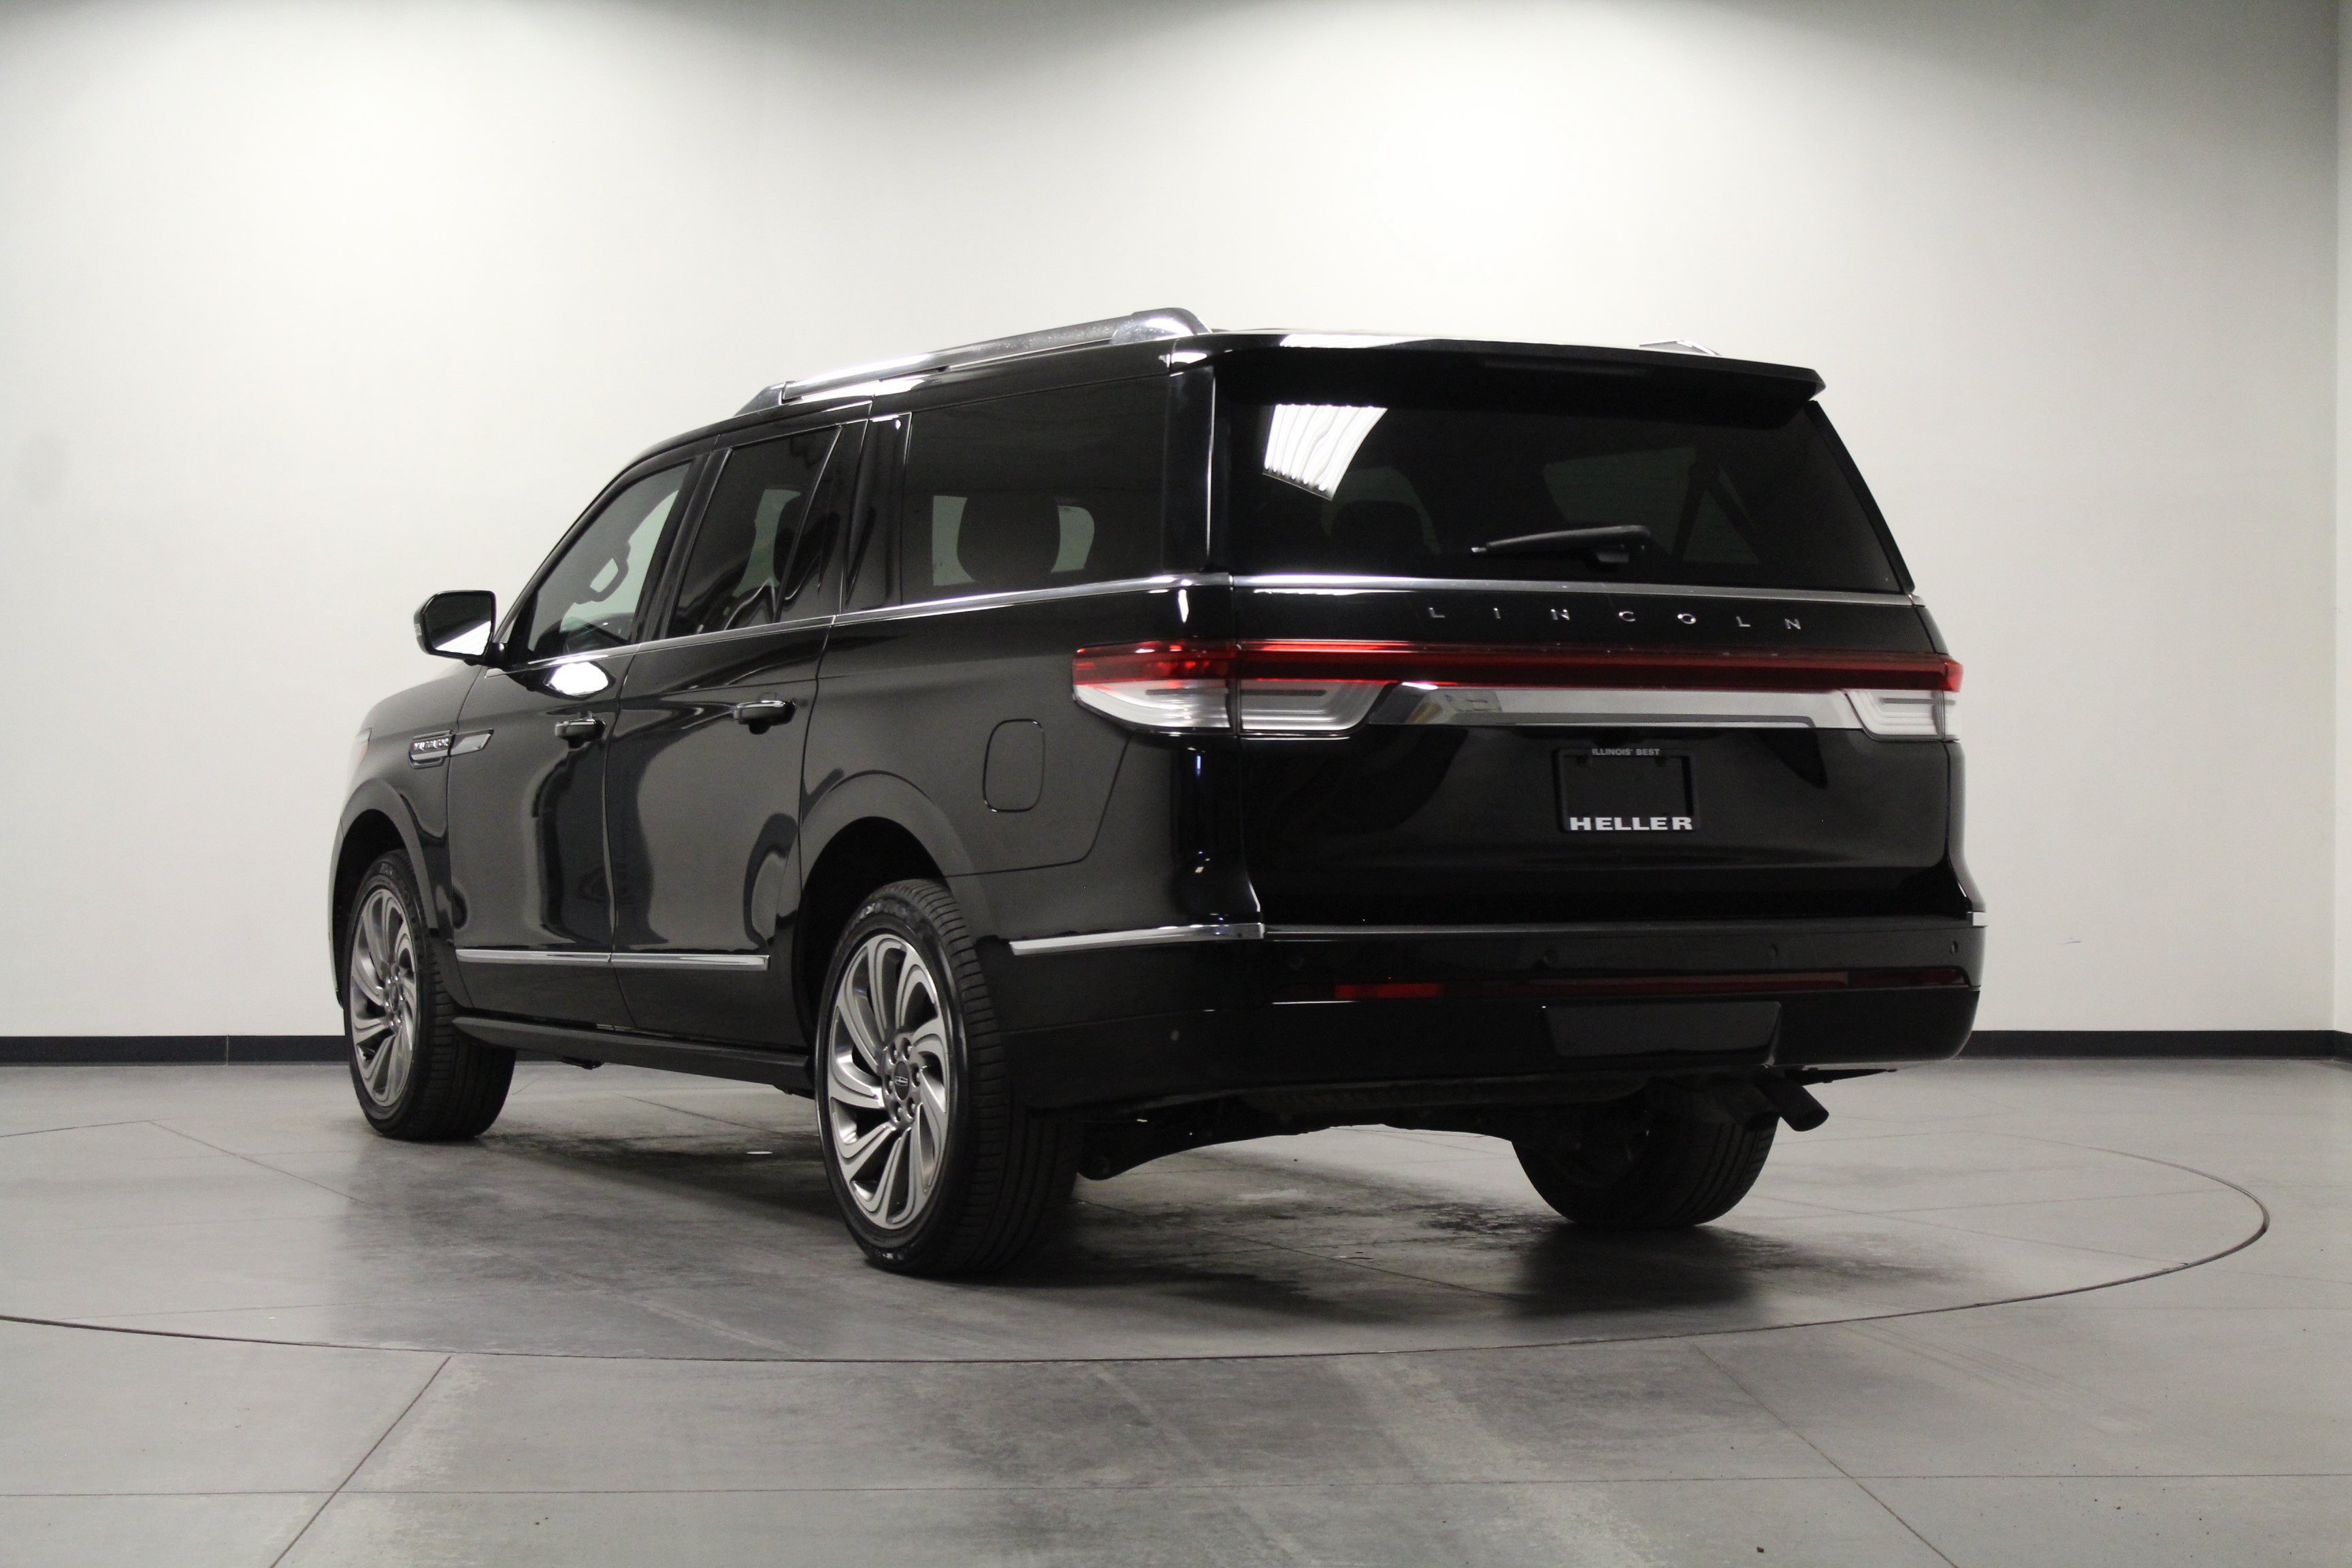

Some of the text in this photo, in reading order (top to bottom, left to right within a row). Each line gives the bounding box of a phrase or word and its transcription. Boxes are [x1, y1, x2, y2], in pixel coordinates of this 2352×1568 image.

[1428, 606, 1801, 630] LINCOLN
[1635, 748, 1661, 756] BEST
[1569, 817, 1693, 831] HELLER
